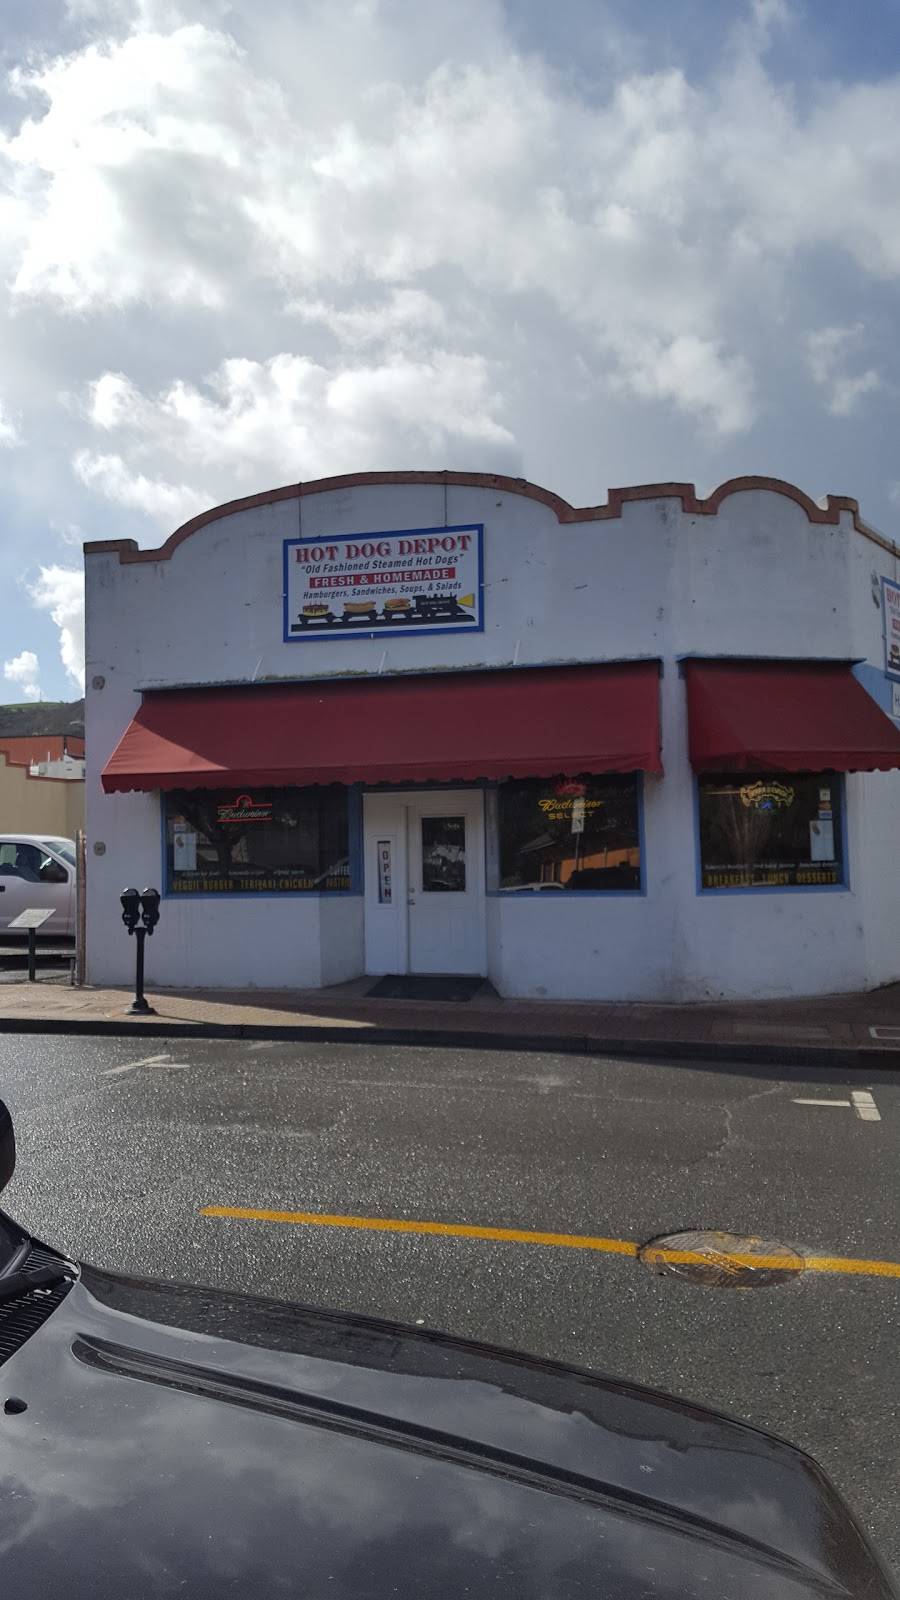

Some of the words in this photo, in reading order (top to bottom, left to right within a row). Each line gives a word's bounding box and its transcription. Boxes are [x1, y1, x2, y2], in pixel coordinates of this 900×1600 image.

[295, 545, 338, 563] HOT
[345, 541, 391, 559] DOG
[398, 535, 472, 554] DEPOT
[323, 559, 370, 573] Fashioned
[372, 556, 413, 569] Steamed
[416, 553, 433, 566] Hot
[314, 575, 354, 587] FRESH
[361, 573, 369, 584] &
[374, 568, 449, 583] HOMEMADE
[303, 588, 350, 600] Hamburgers,
[351, 585, 398, 597] Sandwiches,
[399, 583, 425, 594] Soups,
[427, 583, 433, 591] &
[435, 581, 462, 591] Salads
[382, 850, 392, 898] OPEN
